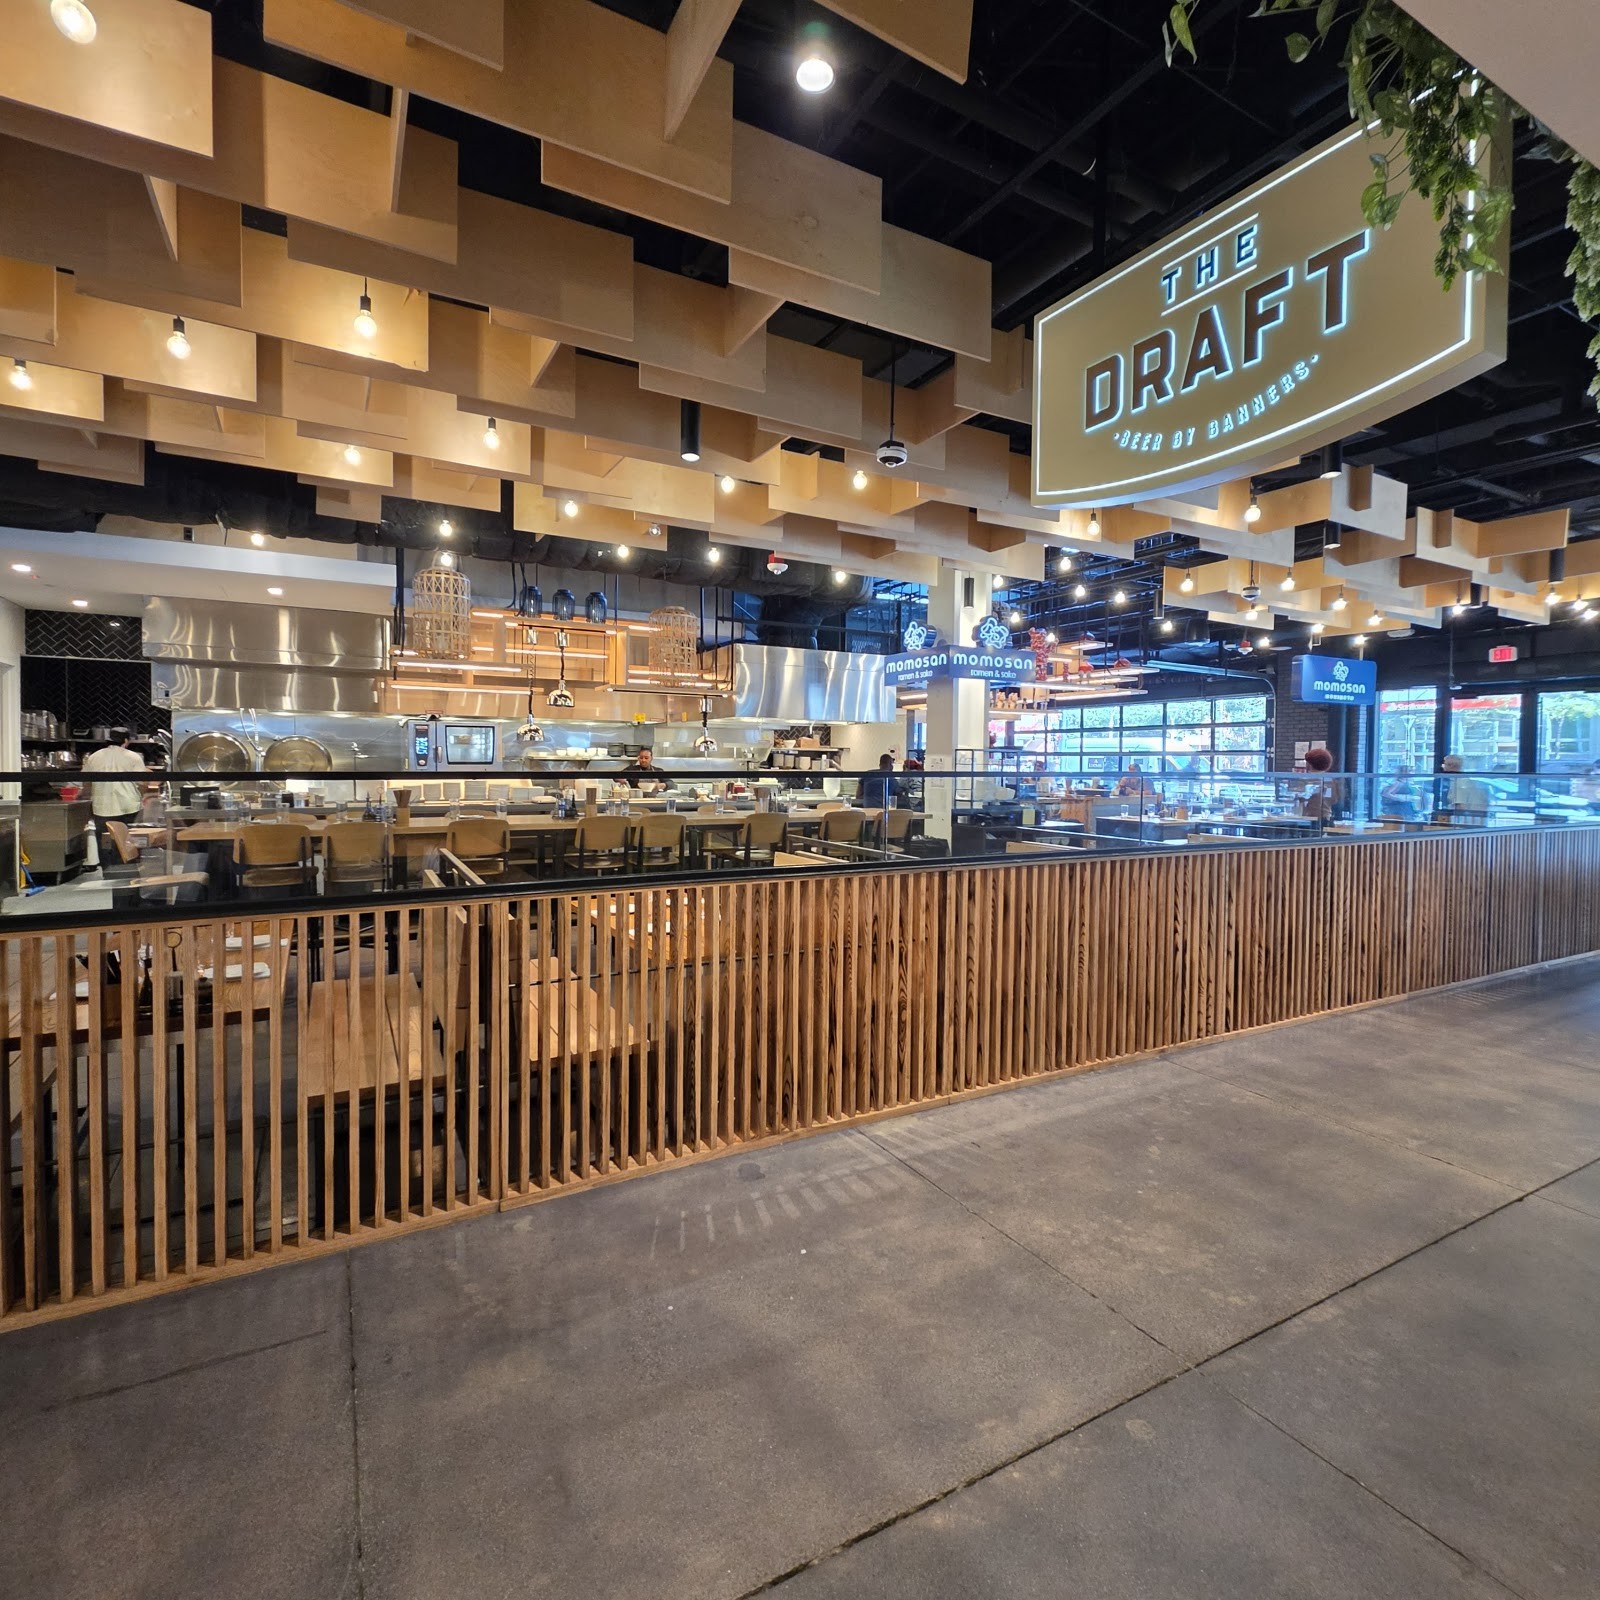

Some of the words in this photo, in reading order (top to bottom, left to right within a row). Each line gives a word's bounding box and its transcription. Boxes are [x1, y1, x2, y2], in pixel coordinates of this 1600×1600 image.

[1160, 224, 1258, 304] THE
[1084, 228, 1370, 433] DRAFT
[1119, 429, 1163, 451] BEER
[1172, 427, 1196, 449] BY
[1208, 361, 1310, 440] BANNERS
[886, 653, 947, 674] momosan
[953, 653, 1033, 670] momosan
[970, 670, 993, 678] ramen
[994, 670, 1000, 678] &
[1313, 680, 1366, 694] momosan
